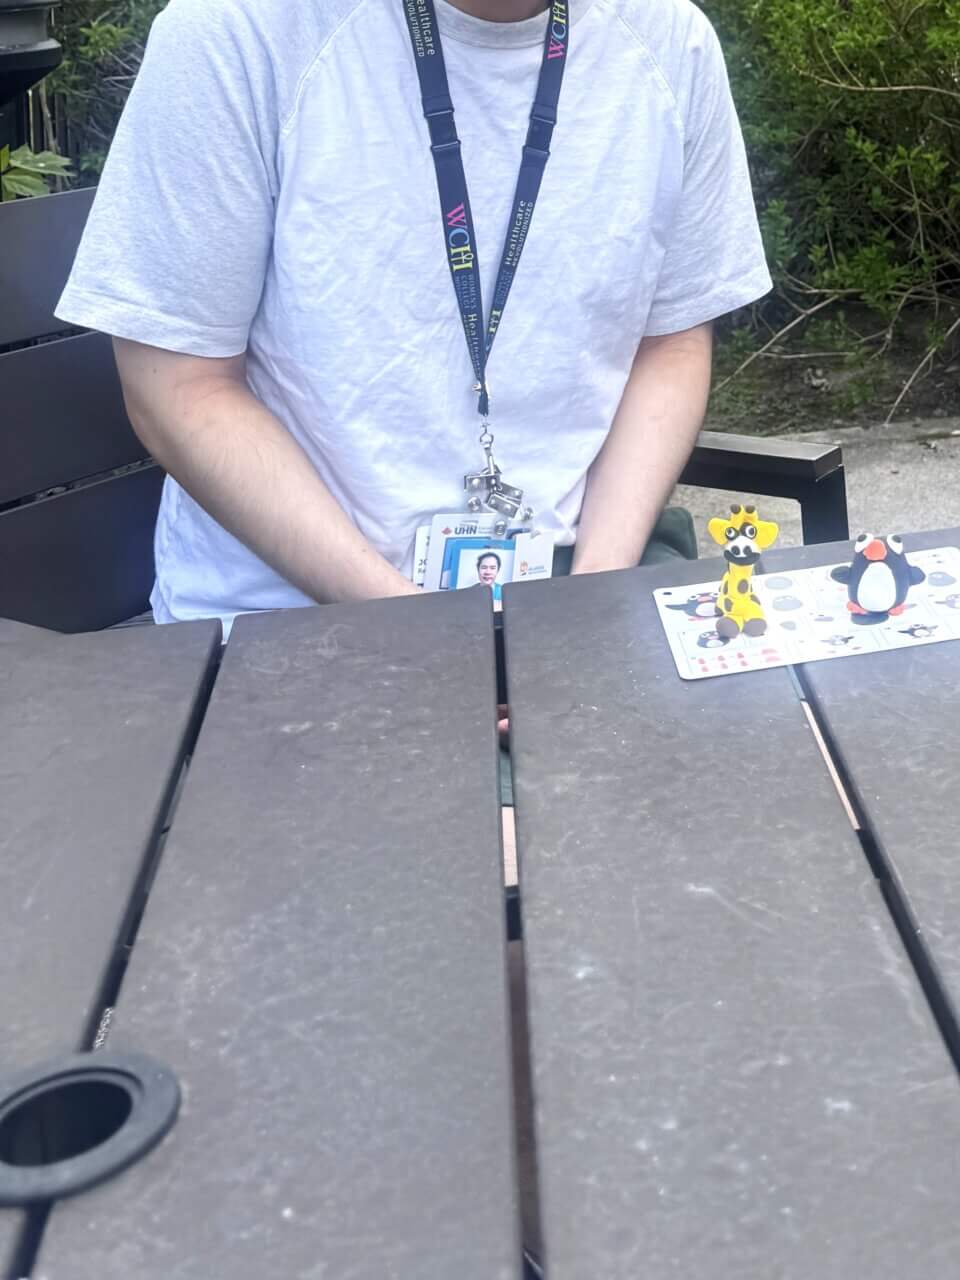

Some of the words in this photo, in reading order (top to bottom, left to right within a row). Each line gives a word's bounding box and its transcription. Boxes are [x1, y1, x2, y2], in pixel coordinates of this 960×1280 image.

[547, 0, 566, 59] WCH
[446, 202, 474, 272] WCH
[505, 200, 527, 265] Healthcare
[454, 525, 477, 535] UHN
